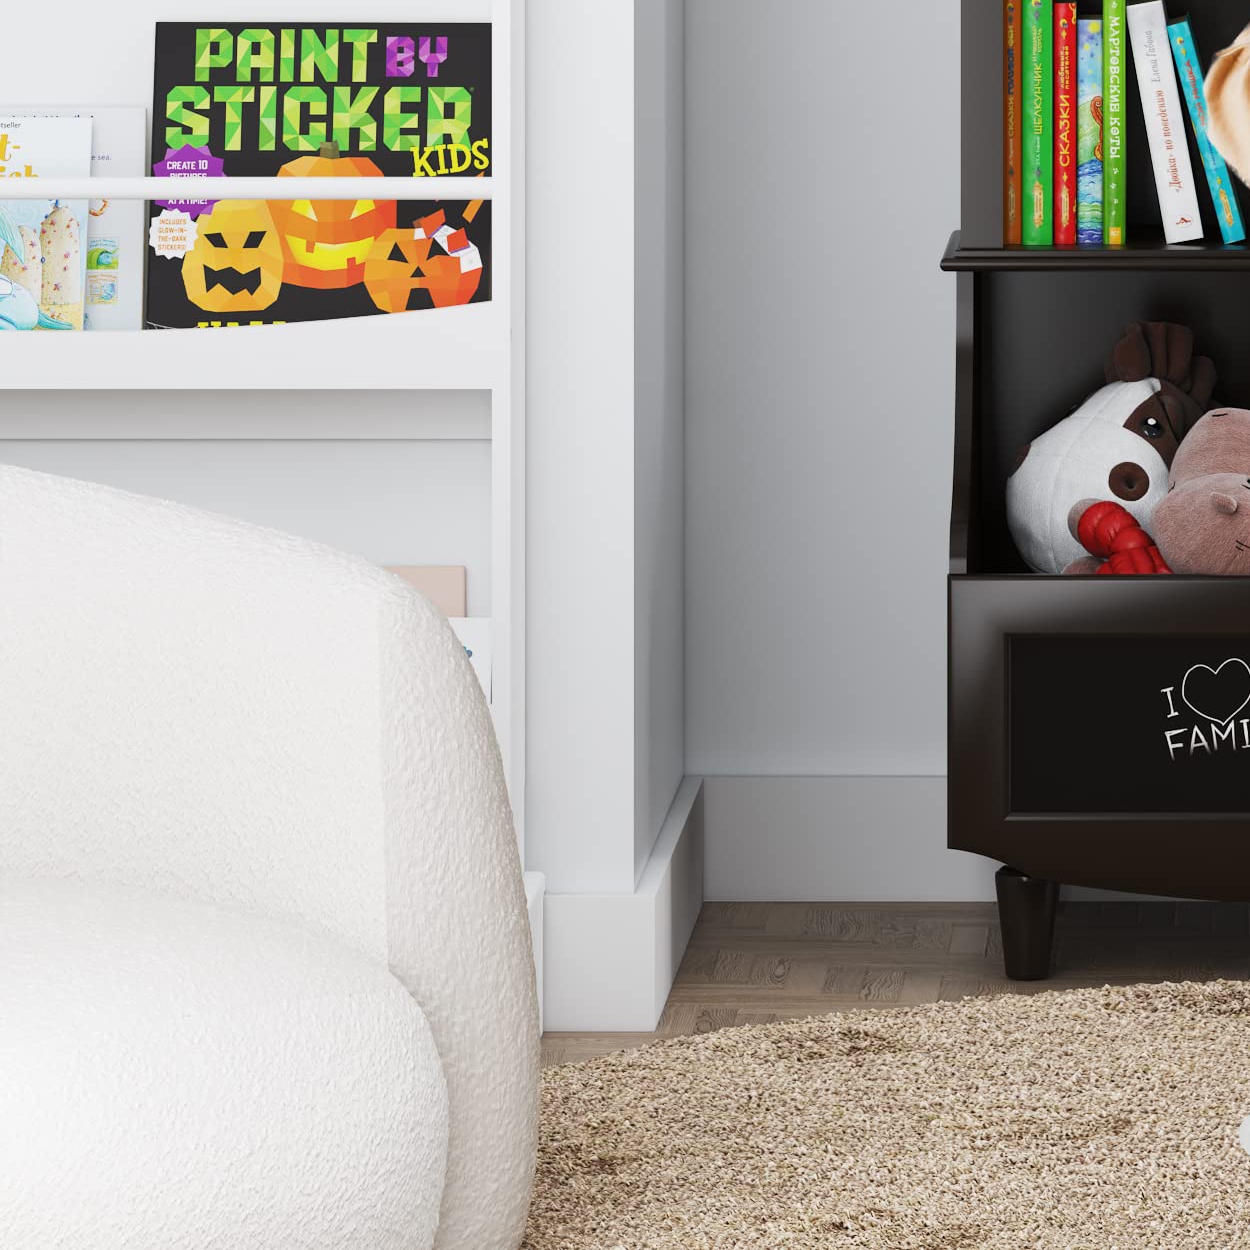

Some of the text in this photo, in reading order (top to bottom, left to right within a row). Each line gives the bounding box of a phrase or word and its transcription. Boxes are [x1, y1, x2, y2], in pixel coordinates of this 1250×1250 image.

[194, 29, 448, 83] PAINT BY
[1150, 59, 1161, 83] Елена
[1109, 15, 1120, 159] МАРТОВСКИЕ КОТЫ
[165, 85, 473, 152] STICKER
[1059, 94, 1070, 167] СКАЗКИ
[1155, 90, 1172, 137] поведению
[166, 159, 209, 170] CREATE 10
[409, 137, 491, 178] KIDS
[1165, 139, 1176, 150] по
[1160, 686, 1179, 718] I
